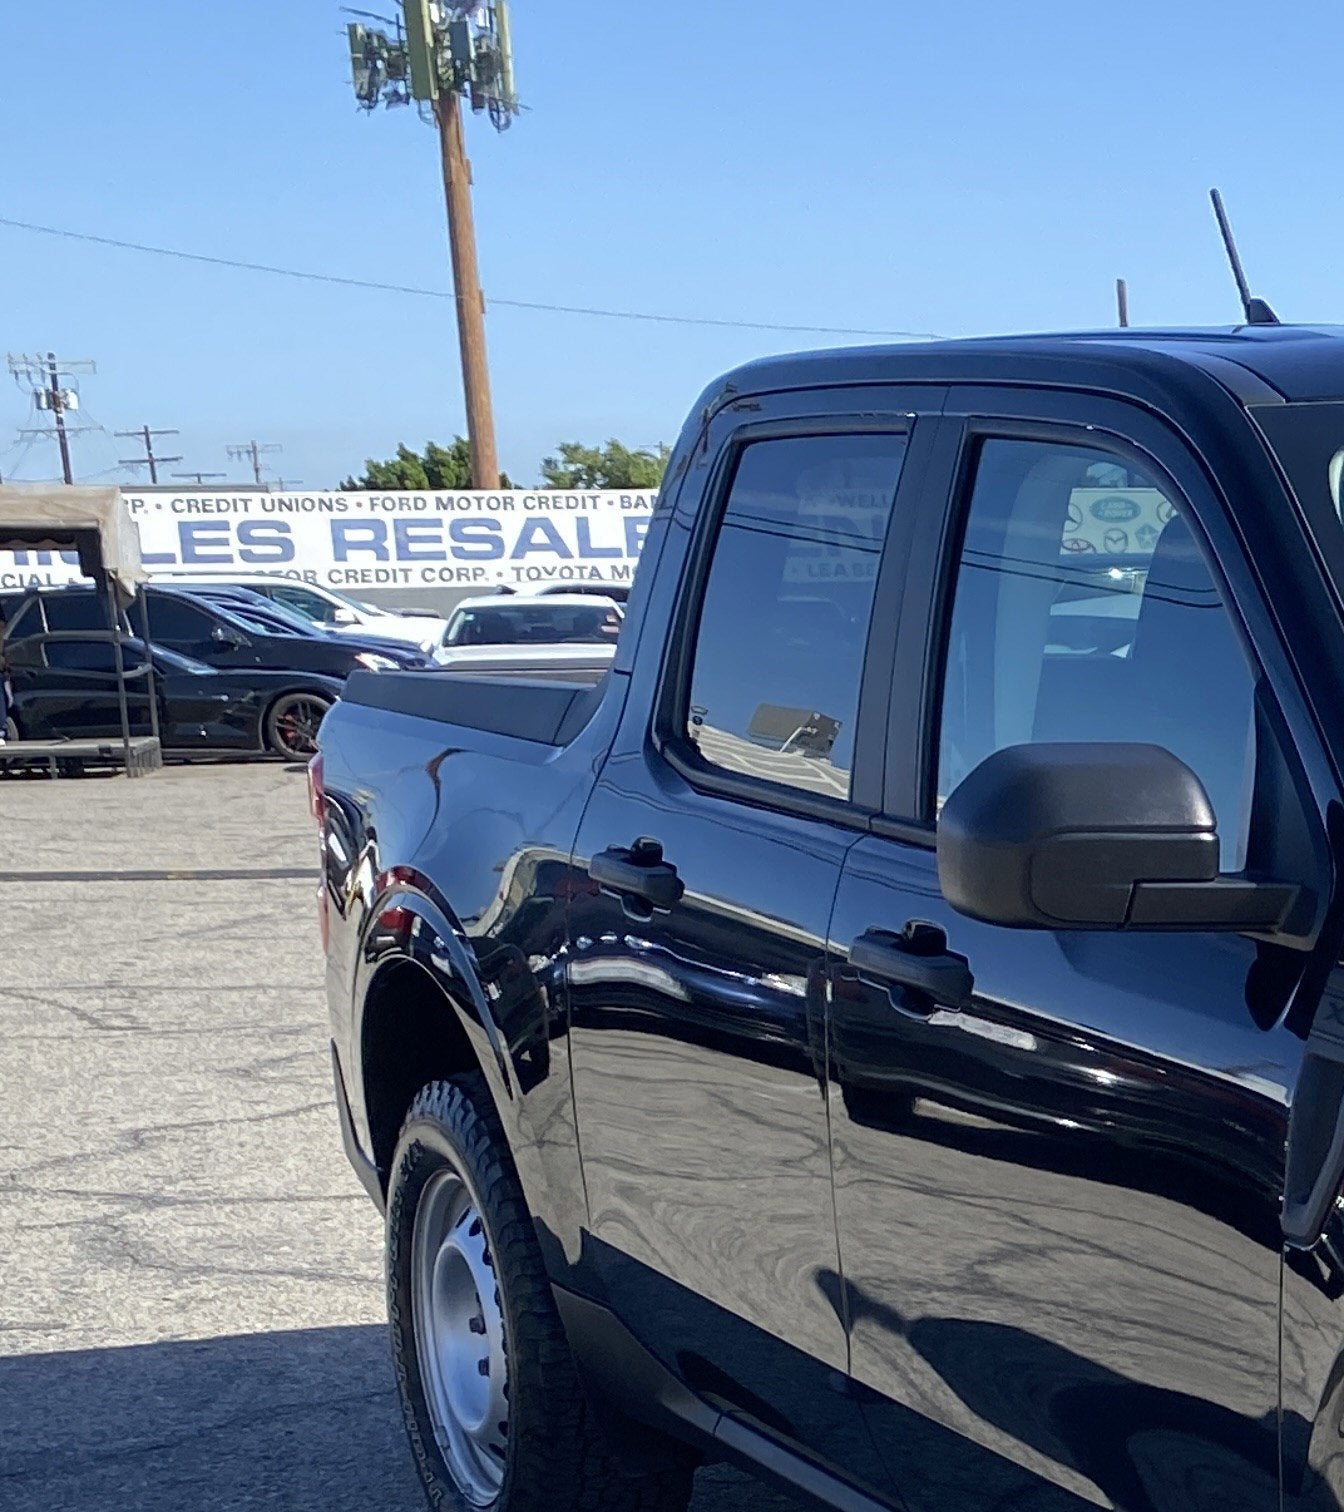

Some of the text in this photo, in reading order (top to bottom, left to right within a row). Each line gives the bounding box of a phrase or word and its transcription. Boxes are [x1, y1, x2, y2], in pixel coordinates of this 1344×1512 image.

[171, 498, 253, 514] CREDIT
[261, 497, 349, 513] UNIONS
[369, 496, 428, 512] FORD
[435, 495, 516, 511] MOTOR
[522, 495, 602, 511] CREDIT
[327, 567, 413, 584] CREDIT
[420, 566, 490, 583] CORP.
[510, 565, 604, 582] TOYOTA
[610, 564, 637, 580] M
